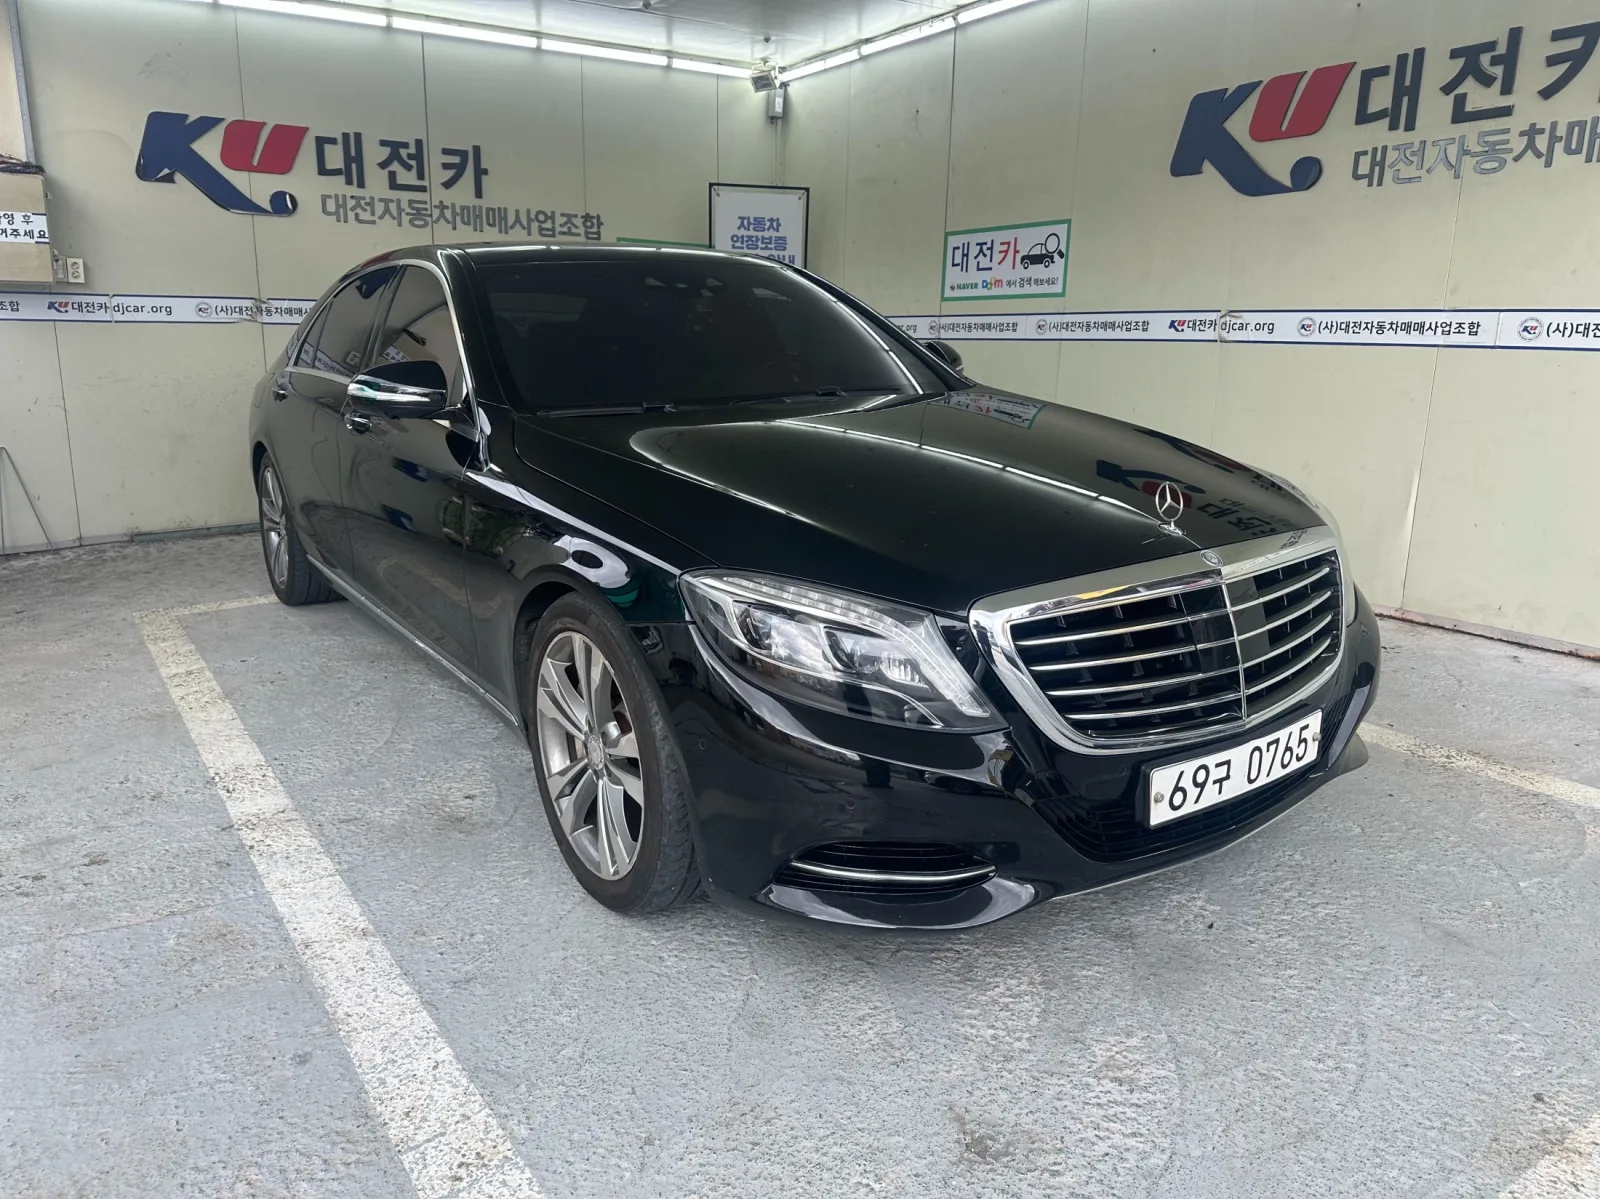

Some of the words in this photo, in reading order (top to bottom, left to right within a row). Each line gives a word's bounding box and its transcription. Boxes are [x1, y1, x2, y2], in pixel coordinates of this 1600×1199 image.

[314, 131, 489, 200] 대전카
[21, 213, 34, 226] 후
[320, 193, 604, 241] 대전자동차매매사업조합
[736, 215, 782, 233] 자동차
[730, 234, 788, 252] 연장보증
[951, 236, 1020, 273] 대전카
[956, 282, 979, 291] NAVER
[1005, 279, 1017, 288] 에서
[1018, 276, 1033, 289] 검색
[71, 301, 110, 314] 대전카
[112, 302, 173, 316] djcar.org
[1048, 318, 1150, 333] (사)대전자동차매매사업조합
[1187, 318, 1218, 332] 대전카
[1220, 319, 1275, 334] djcar.org
[1318, 320, 1481, 336] (사)대전자동차매매사업조합
[1168, 758, 1232, 812] 69구
[1246, 723, 1310, 785] 0765
